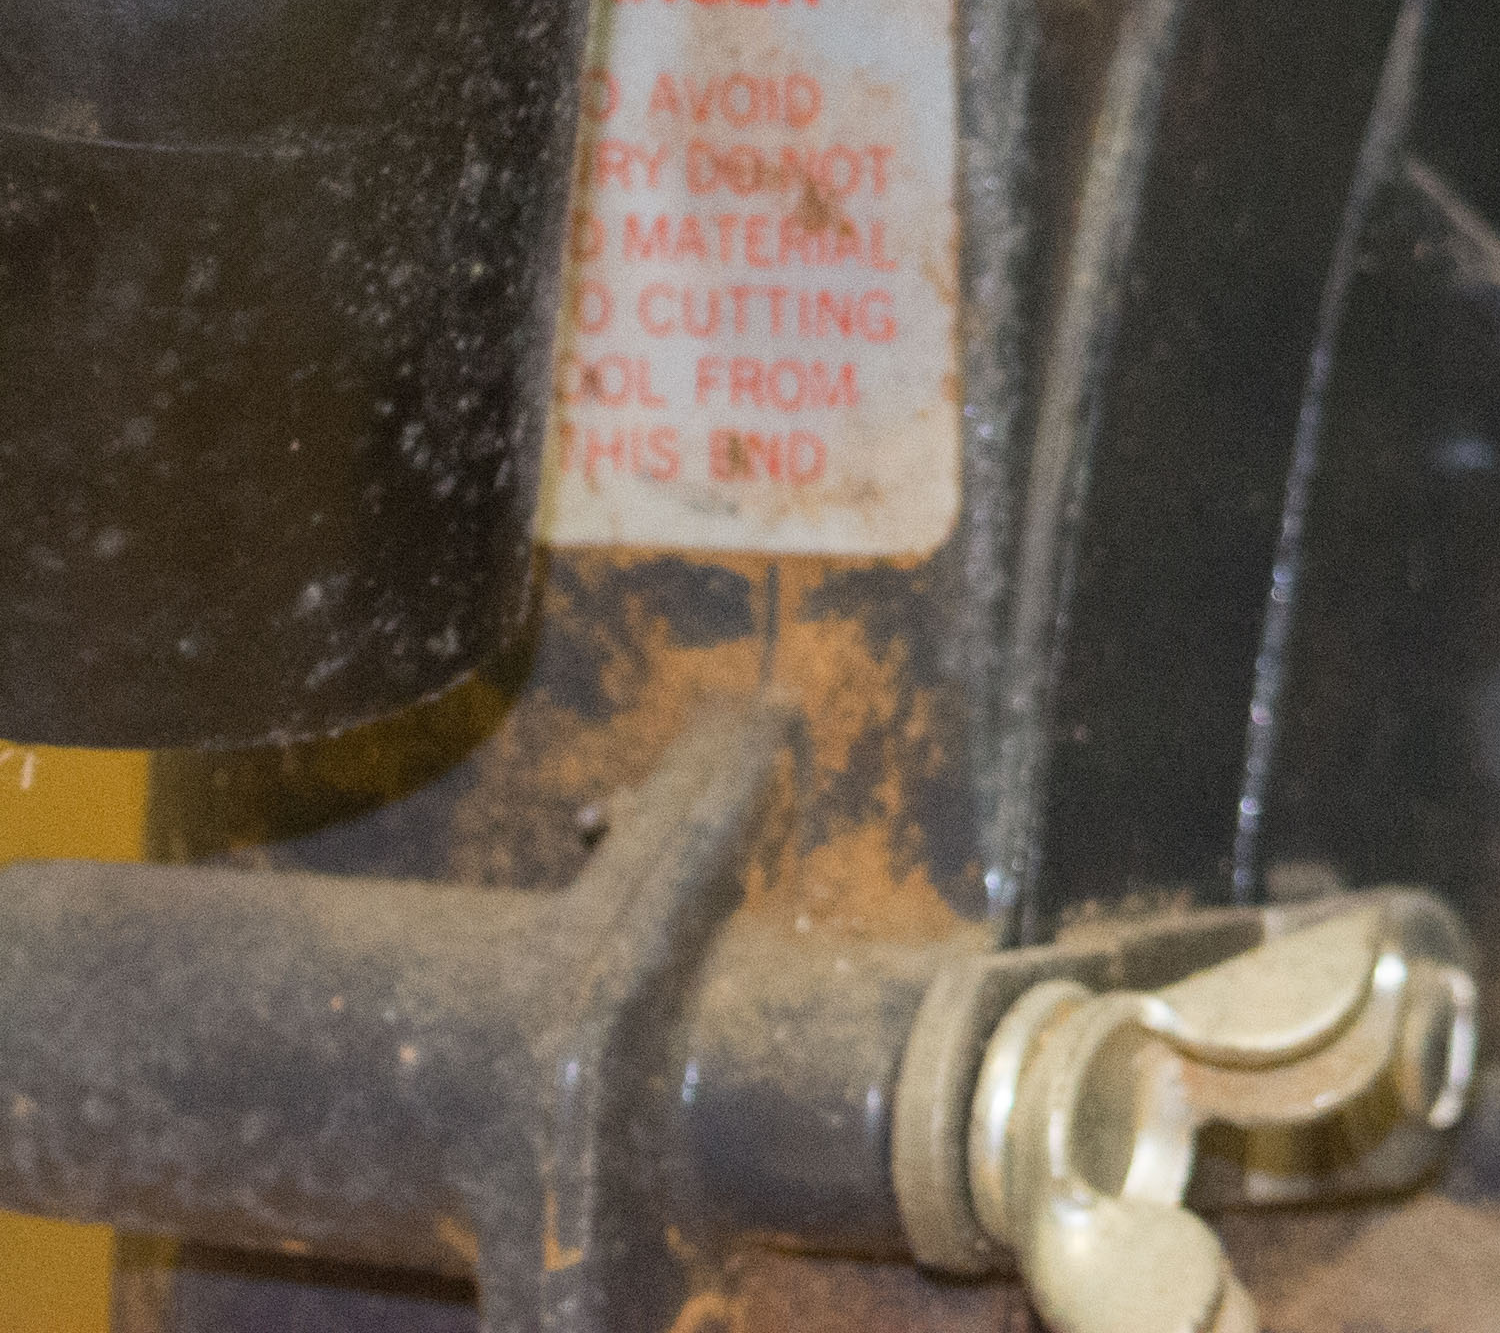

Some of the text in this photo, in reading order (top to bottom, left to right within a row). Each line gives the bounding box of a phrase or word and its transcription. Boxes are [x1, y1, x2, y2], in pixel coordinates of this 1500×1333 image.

[648, 71, 826, 129] AVOID
[684, 137, 764, 198] DO
[778, 143, 897, 199] NOT
[623, 211, 898, 274] MATERIAL
[637, 282, 898, 346] CUTTING
[693, 354, 862, 414] FROM
[707, 426, 829, 487] END
